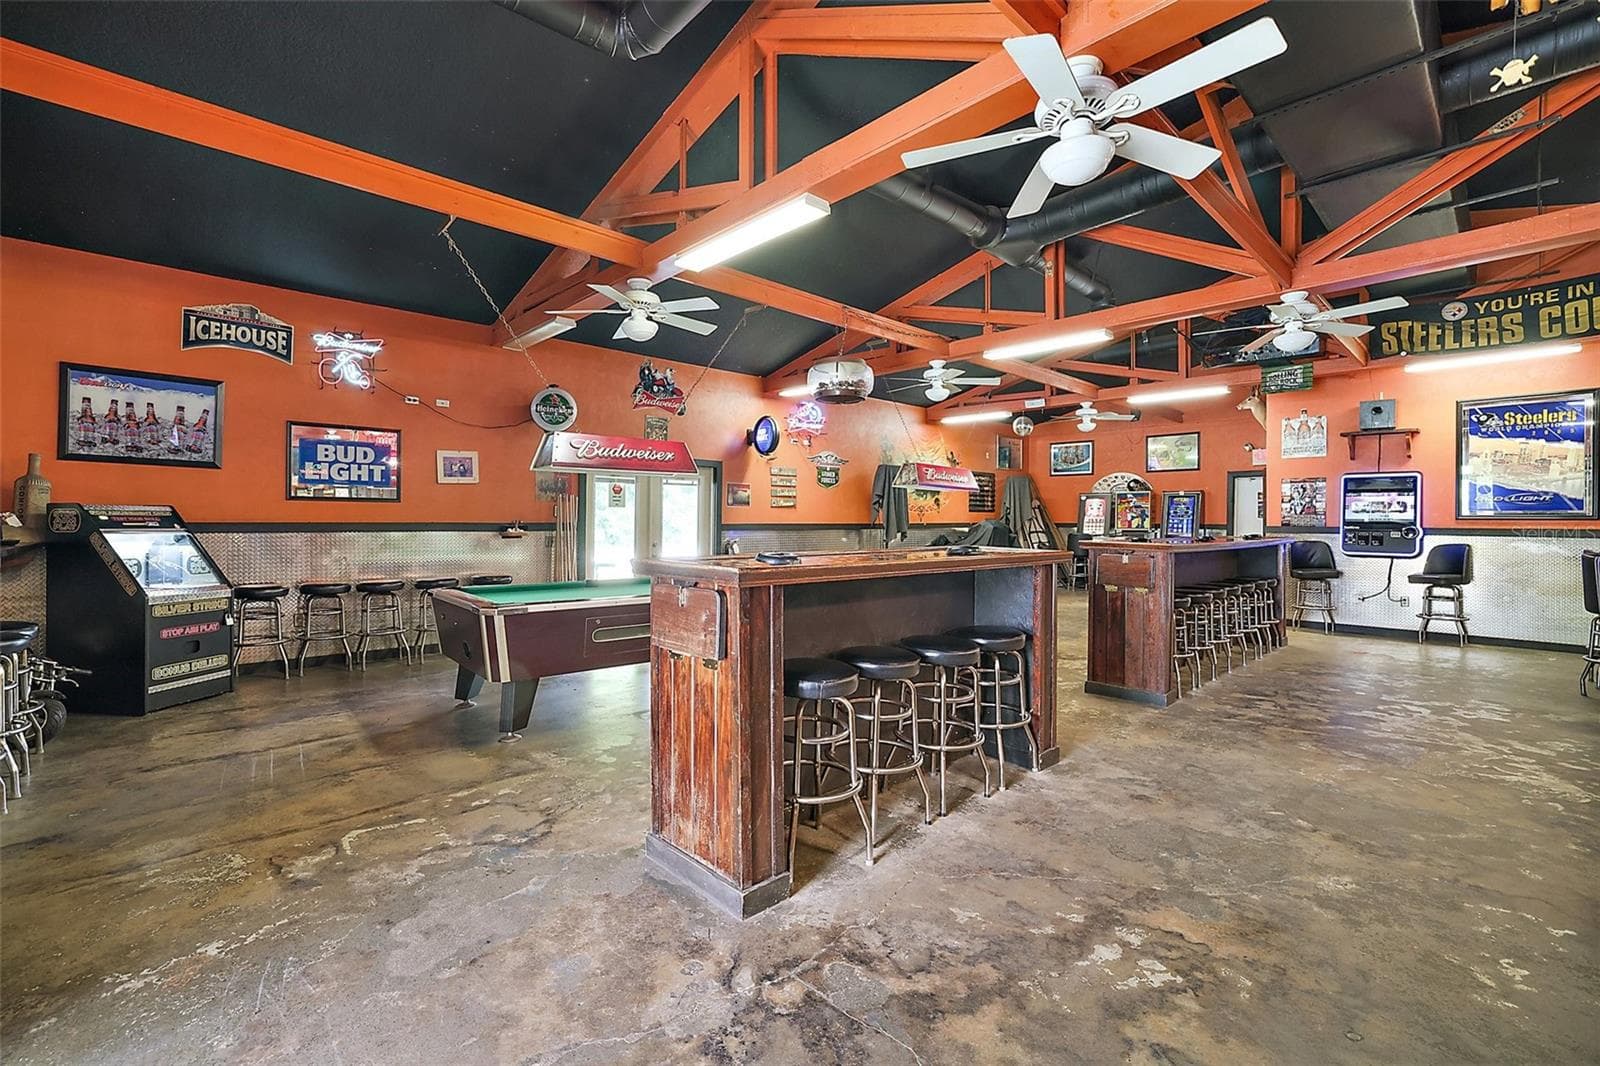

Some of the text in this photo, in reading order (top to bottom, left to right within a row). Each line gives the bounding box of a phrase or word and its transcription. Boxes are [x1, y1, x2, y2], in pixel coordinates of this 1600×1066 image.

[1475, 281, 1595, 314] YOU'RE IN
[188, 315, 289, 355] ICEHOUSE
[1381, 296, 1600, 355] STEELERS CO
[1503, 409, 1577, 426] Steelers
[317, 443, 376, 464] BUD
[569, 438, 676, 462] Budweiser
[304, 461, 386, 482] LIGHT
[924, 468, 968, 483] Budweiser
